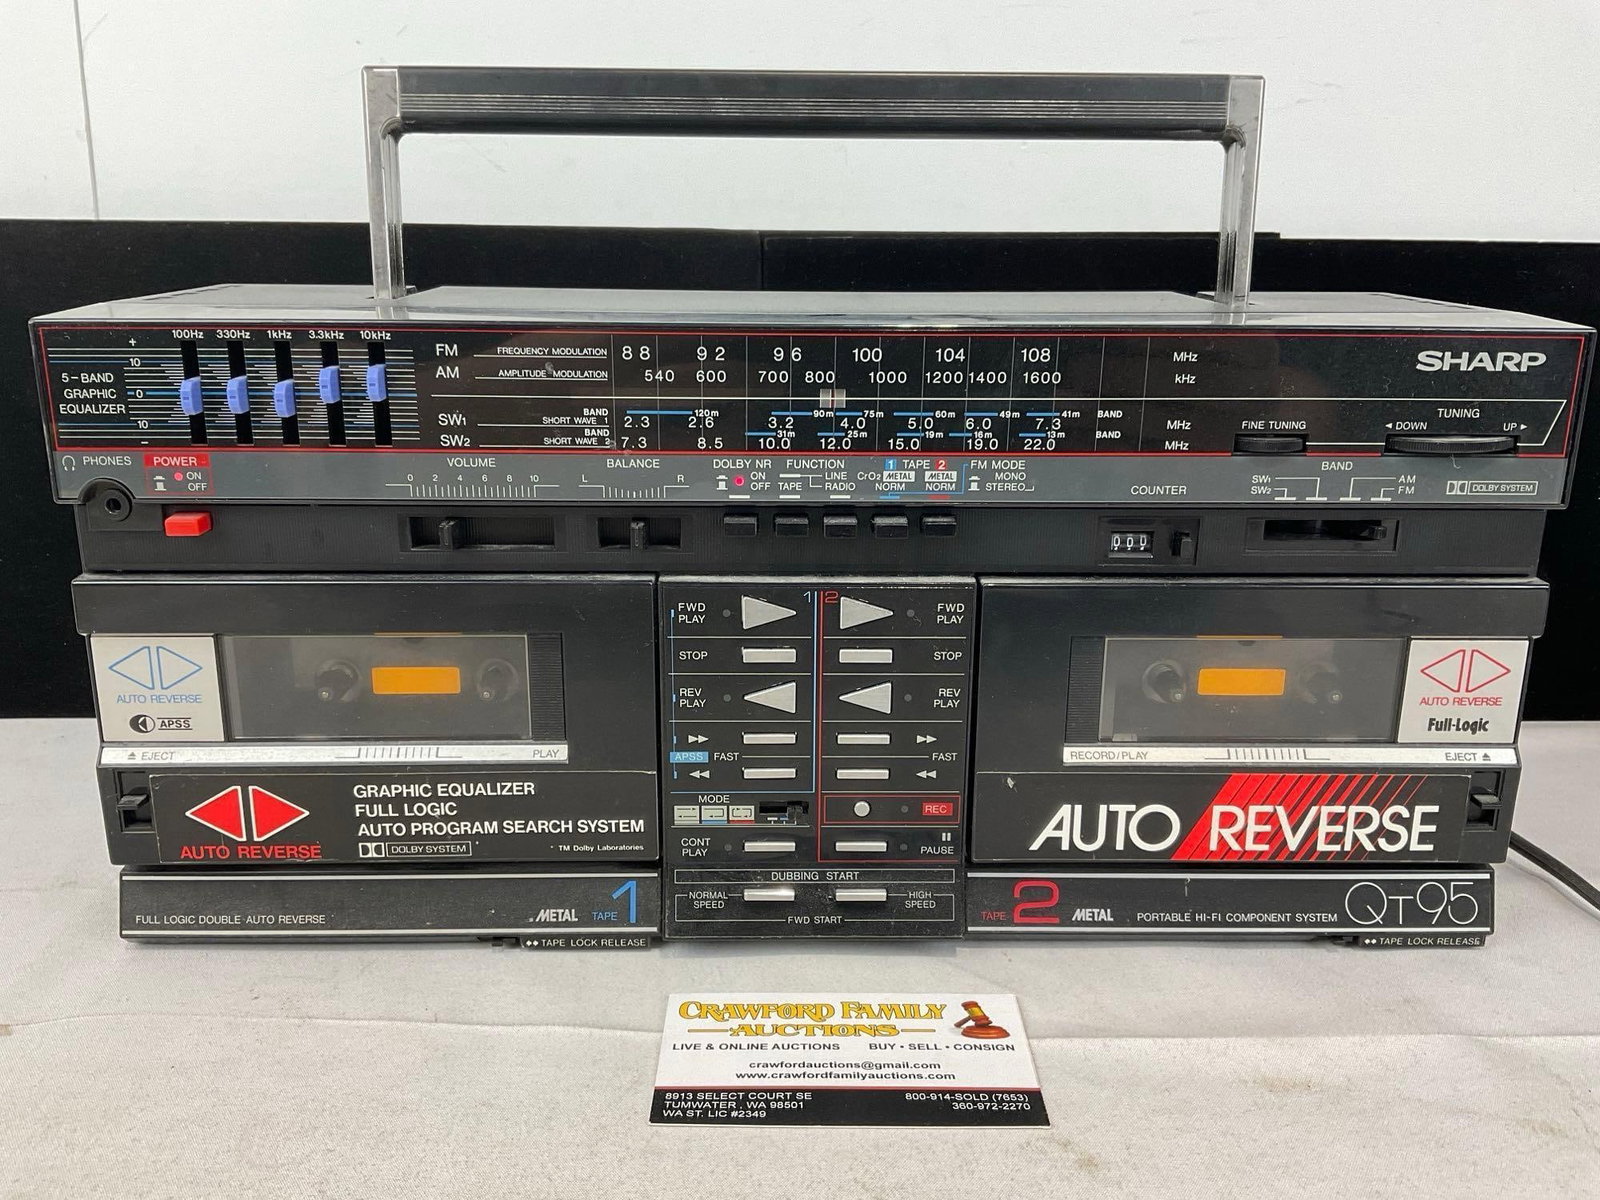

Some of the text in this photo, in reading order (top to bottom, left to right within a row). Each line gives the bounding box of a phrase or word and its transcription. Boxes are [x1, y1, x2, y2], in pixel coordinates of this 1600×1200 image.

[172, 330, 391, 340] 100Hz 330Hz 1kHz 3.3kHz 10kHz
[436, 344, 1198, 363] FM FREQUENCY MODULATION 100 104 108 MHz
[1415, 350, 1547, 372] SHARP
[435, 366, 1196, 384] AM AMPLITUDE MODULATION 540 600 700 800 1000 1200 1400 1600 kHz
[64, 388, 117, 399] GRAPHIC
[59, 404, 126, 414] EQUALIZER
[583, 408, 608, 416] BAND
[694, 409, 719, 417] 120m
[1437, 408, 1480, 419] TUNING
[813, 410, 834, 418] 90m
[863, 410, 884, 418] 75m
[935, 410, 956, 419] 60m
[999, 410, 1020, 419] 49m
[1061, 410, 1080, 419] 41m
[542, 416, 597, 425] SHORT WAVE
[624, 416, 1191, 430] 2.3 2.6 3.2 4.0 5.0 6.0 7.3 MHz
[1242, 421, 1306, 431] FINE TUNING
[1396, 421, 1427, 430] DOWN
[1503, 422, 1517, 431] UP
[83, 456, 132, 466] PHONES
[153, 456, 197, 467] POWER
[447, 458, 496, 468] VOLUME
[606, 459, 660, 469] BALANCE
[713, 459, 772, 469] DOLBY NR
[786, 459, 845, 469] FUNCTION
[902, 460, 930, 469] TAPE
[970, 460, 1026, 470] FM MODE
[1321, 461, 1353, 471] BAND
[750, 472, 766, 480] ON
[825, 472, 847, 480] LINE
[885, 472, 912, 480] METAL
[995, 472, 1026, 480] MONO
[750, 483, 771, 491] OFF
[778, 483, 802, 491] TAPE
[825, 483, 856, 491] RADIO
[875, 483, 906, 491] NORM
[985, 483, 1026, 491] STEREO
[1131, 485, 1187, 495] COUNTER
[678, 603, 706, 612] FWD
[678, 615, 706, 624] PLAY
[679, 651, 708, 660] STOP
[679, 688, 702, 697] REV
[116, 694, 203, 704] AUTO REVERSE
[679, 699, 706, 708] PLAY
[1420, 697, 1503, 707] AUTO REVERSE
[159, 718, 191, 729] APSS
[1428, 717, 1490, 734] Full-Logic
[140, 751, 175, 762] EJECT
[532, 748, 560, 759] PLAY
[674, 753, 703, 761] APSS
[714, 753, 739, 761] FAST
[1070, 750, 1149, 761] RECORD/PLAY
[353, 781, 535, 799] GRAPHIC EQUALIZER
[698, 795, 730, 804] MODE
[355, 802, 458, 818] FULL LOGIC
[924, 805, 947, 814] REC
[358, 819, 644, 836] AUTO PROGRAM SEARCH SYSTEM
[1029, 804, 1439, 852] AUTO REVERSE
[681, 838, 711, 847] CONT
[180, 844, 322, 860] AUTO REVERSE
[390, 844, 466, 854] DOLBY SYSTEM
[572, 844, 595, 853] Dolby
[597, 844, 644, 852] Laboratories
[682, 849, 708, 857] PLAY
[920, 846, 954, 855] PAUSE
[771, 872, 859, 881] DUBBING START
[689, 892, 728, 900] NORMAL
[592, 881, 637, 923] TAPE 1
[693, 901, 725, 909] SPEED
[981, 880, 1060, 924] TAPE 2
[135, 914, 325, 925] FULL LOGIC DOUBLE AUTO REVERSE
[535, 909, 578, 923] METAL
[1071, 908, 1114, 922] METAL
[1137, 912, 1337, 922] PORTABLE HI-FI COMPONENT SYSTEM
[787, 916, 842, 924] FWD START
[540, 938, 646, 948] TAPE LOCK RELEASE
[841, 1001, 947, 1021] FAMILY
[730, 1025, 900, 1037] AUCTIONS
[673, 1043, 840, 1051] LIVE & ONLINE AUCTIONS
[869, 1043, 896, 1051] BUY
[908, 1043, 942, 1051] SELL
[749, 1060, 941, 1071] crawfordauctions@gmail.com
[735, 1071, 956, 1081] www.crawfordfamilyauctions.com
[905, 1093, 1028, 1102] 800-914-SOLD (7653)
[746, 1101, 767, 1109] WA
[770, 1101, 804, 1109] 98501
[663, 1110, 766, 1118] WA ST. LIC #2349
